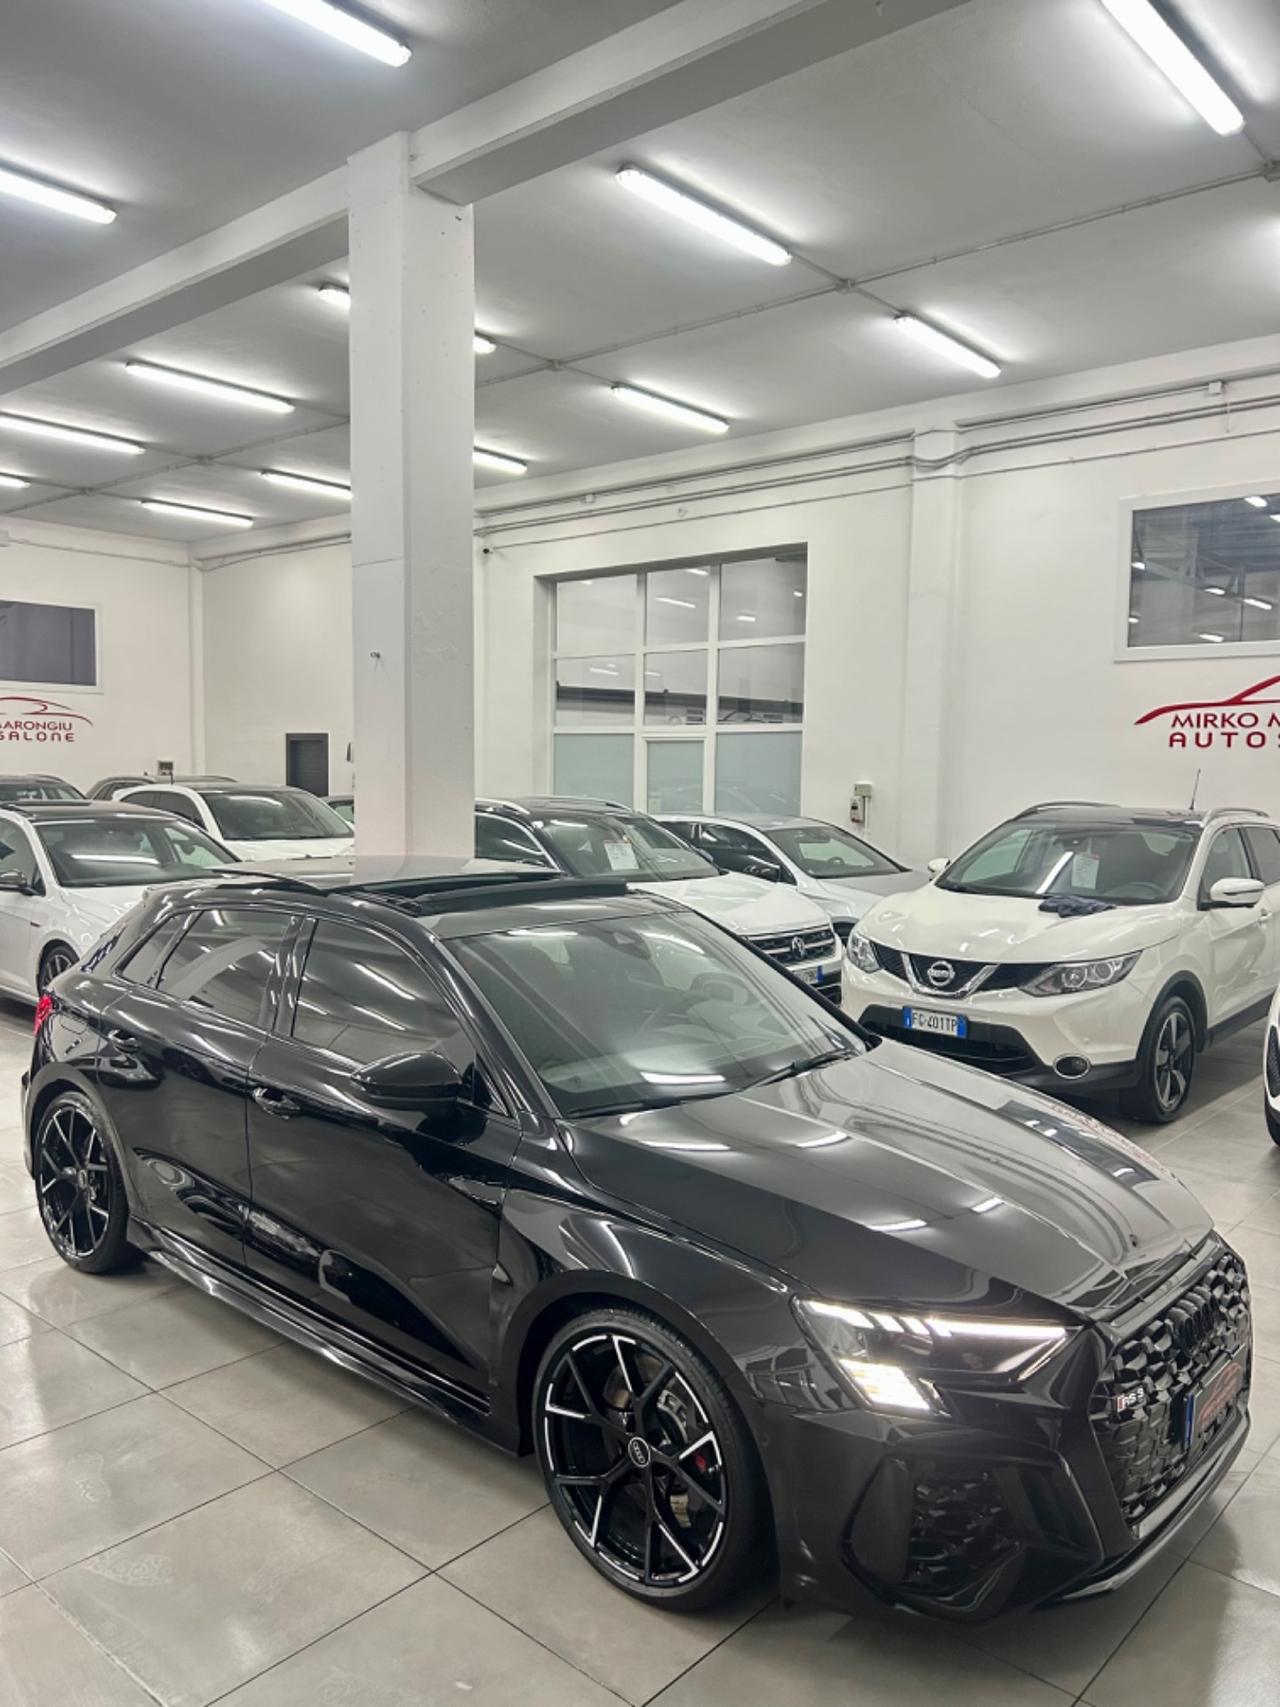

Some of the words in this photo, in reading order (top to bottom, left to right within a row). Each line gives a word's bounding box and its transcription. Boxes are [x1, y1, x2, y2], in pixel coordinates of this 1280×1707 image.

[0, 720, 73, 732] ARONGIU
[1171, 712, 1260, 728] MIRKO
[1168, 731, 1280, 748] AUTO
